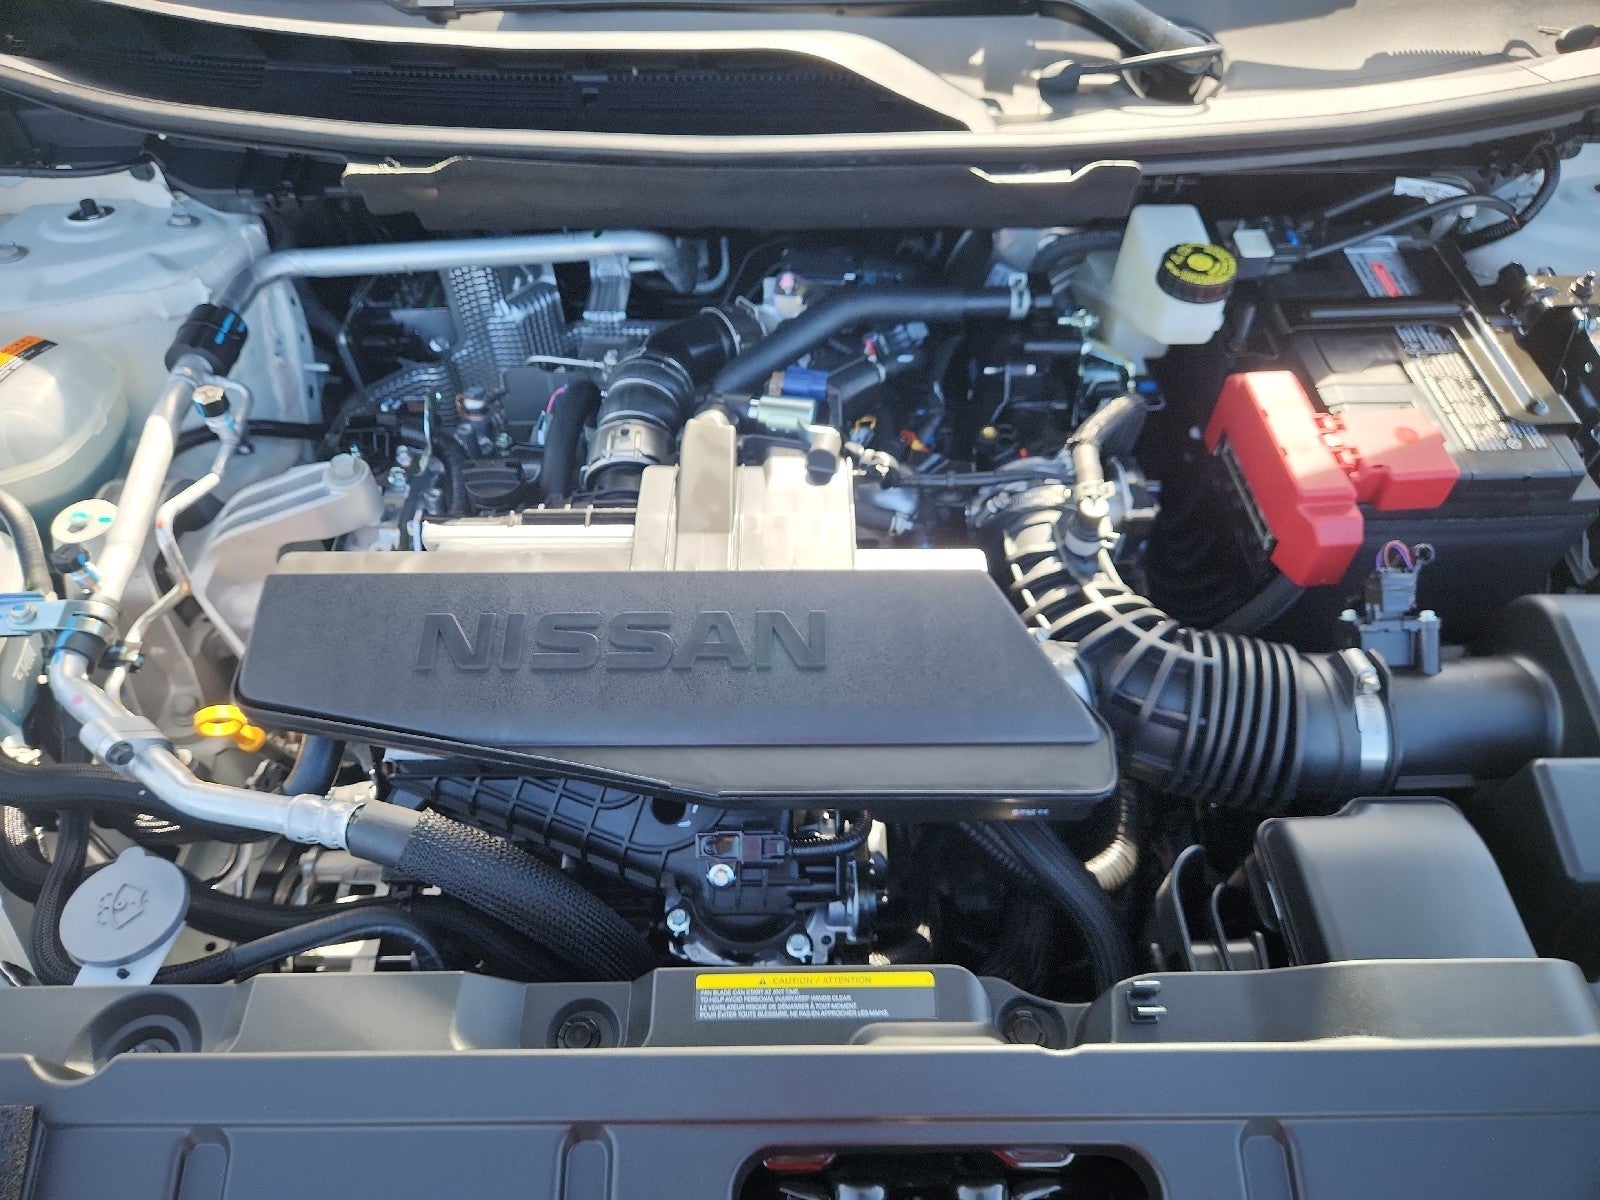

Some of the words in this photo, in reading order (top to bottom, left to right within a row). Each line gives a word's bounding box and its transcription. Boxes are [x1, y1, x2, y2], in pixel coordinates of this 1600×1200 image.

[416, 609, 828, 672] NISSAN
[772, 976, 813, 985] CAUTION
[823, 975, 872, 984] ATTENTION
